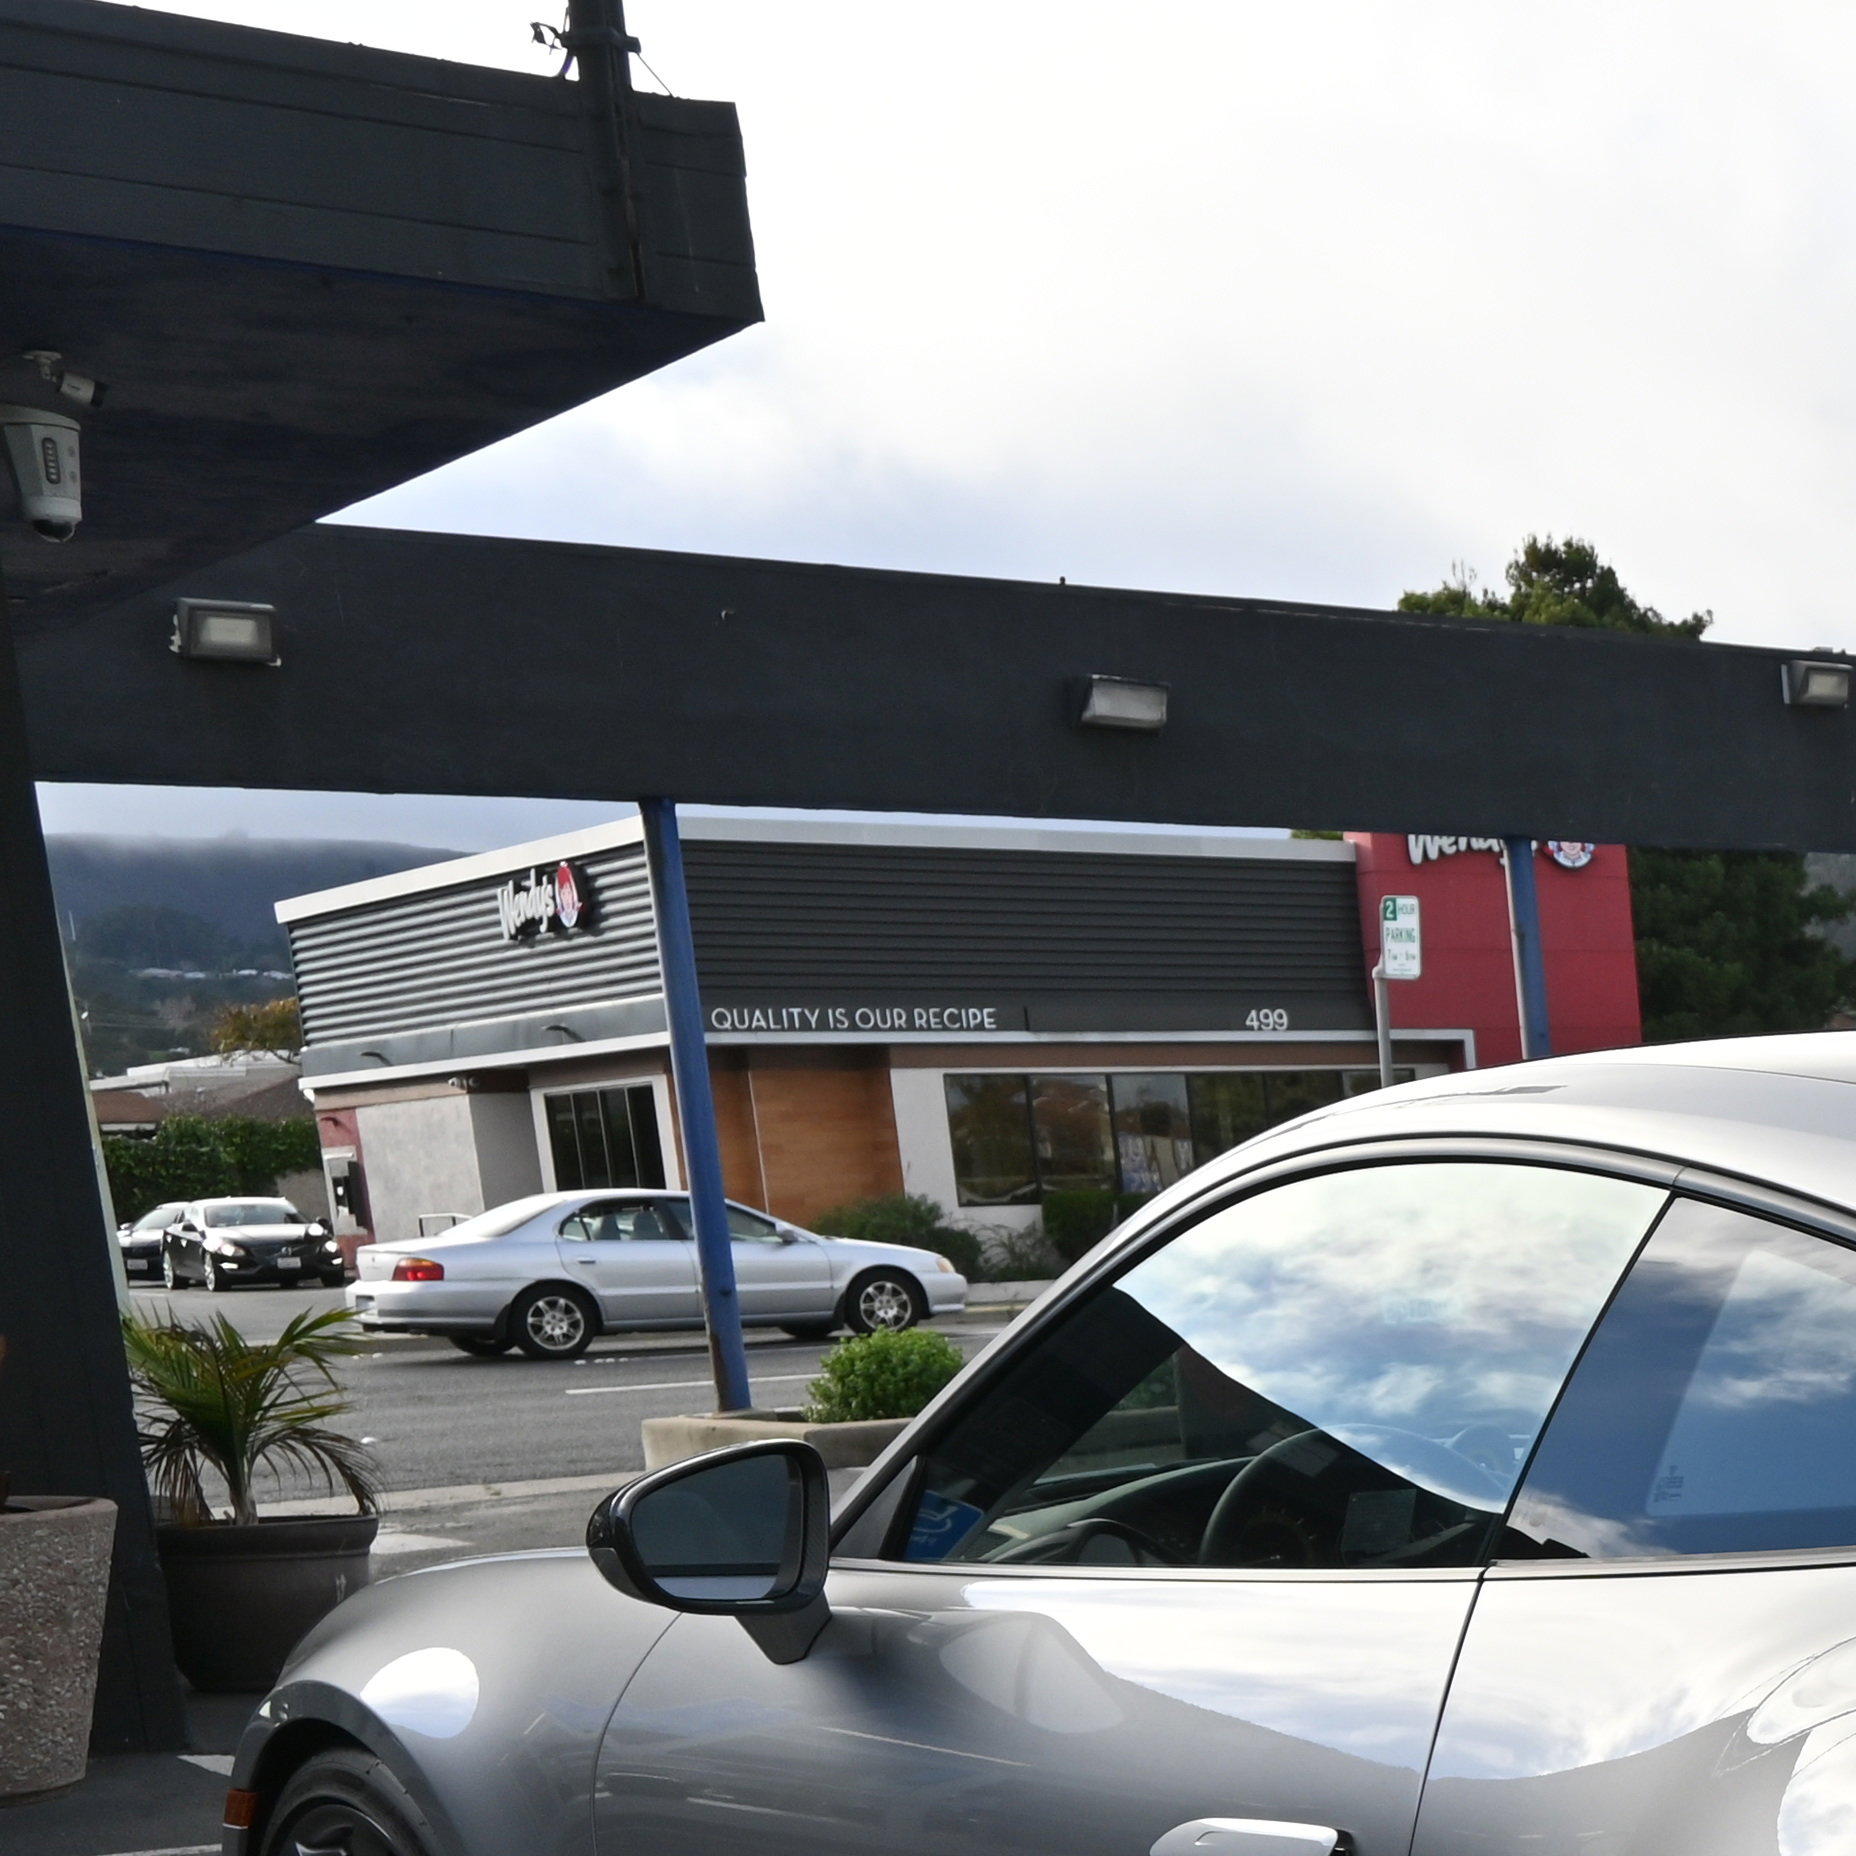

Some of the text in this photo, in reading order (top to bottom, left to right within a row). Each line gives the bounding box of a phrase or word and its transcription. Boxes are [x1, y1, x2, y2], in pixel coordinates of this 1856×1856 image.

[498, 868, 554, 940] Wendy's
[1385, 900, 1415, 919] 2 HOUR
[1385, 927, 1415, 943] PARKING
[711, 1007, 997, 1030] QUALITY IS OUR RECIPE
[1245, 1008, 1288, 1031] 499
